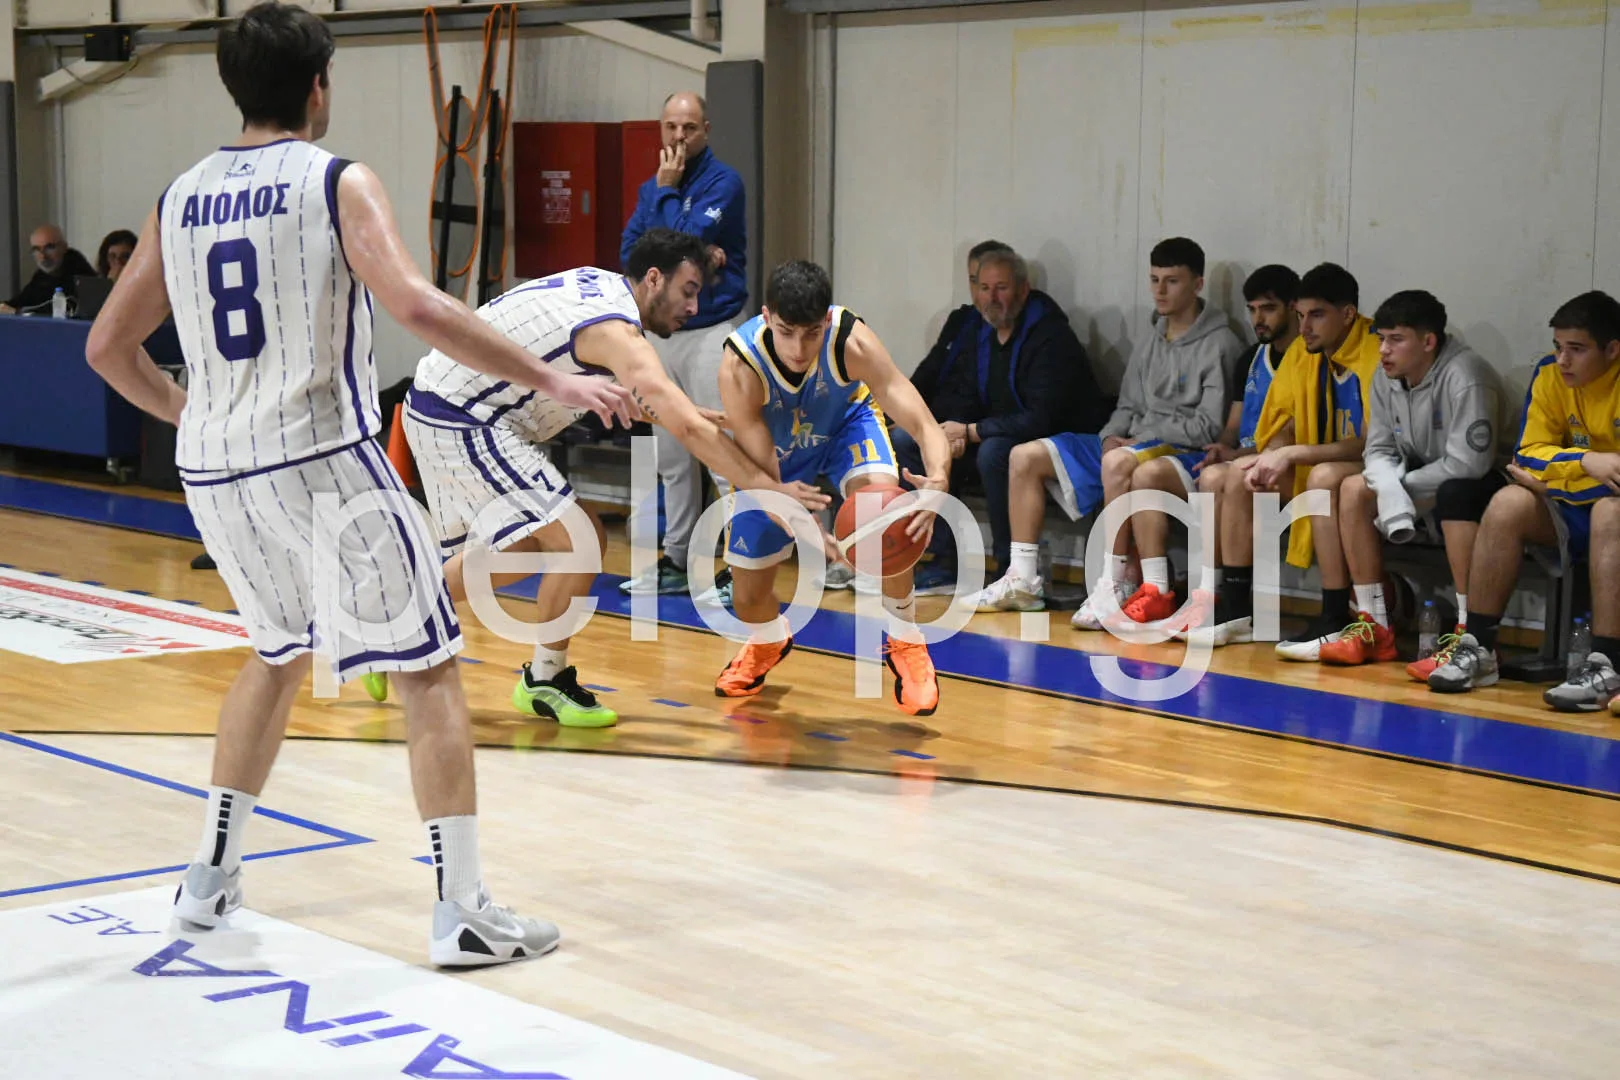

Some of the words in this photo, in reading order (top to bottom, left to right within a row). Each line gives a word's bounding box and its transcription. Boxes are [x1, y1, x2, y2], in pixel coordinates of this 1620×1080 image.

[181, 182, 290, 228] ΑΙΟΛΟΣ
[207, 237, 267, 362] 8
[848, 438, 880, 466] 11
[531, 469, 556, 492] 7
